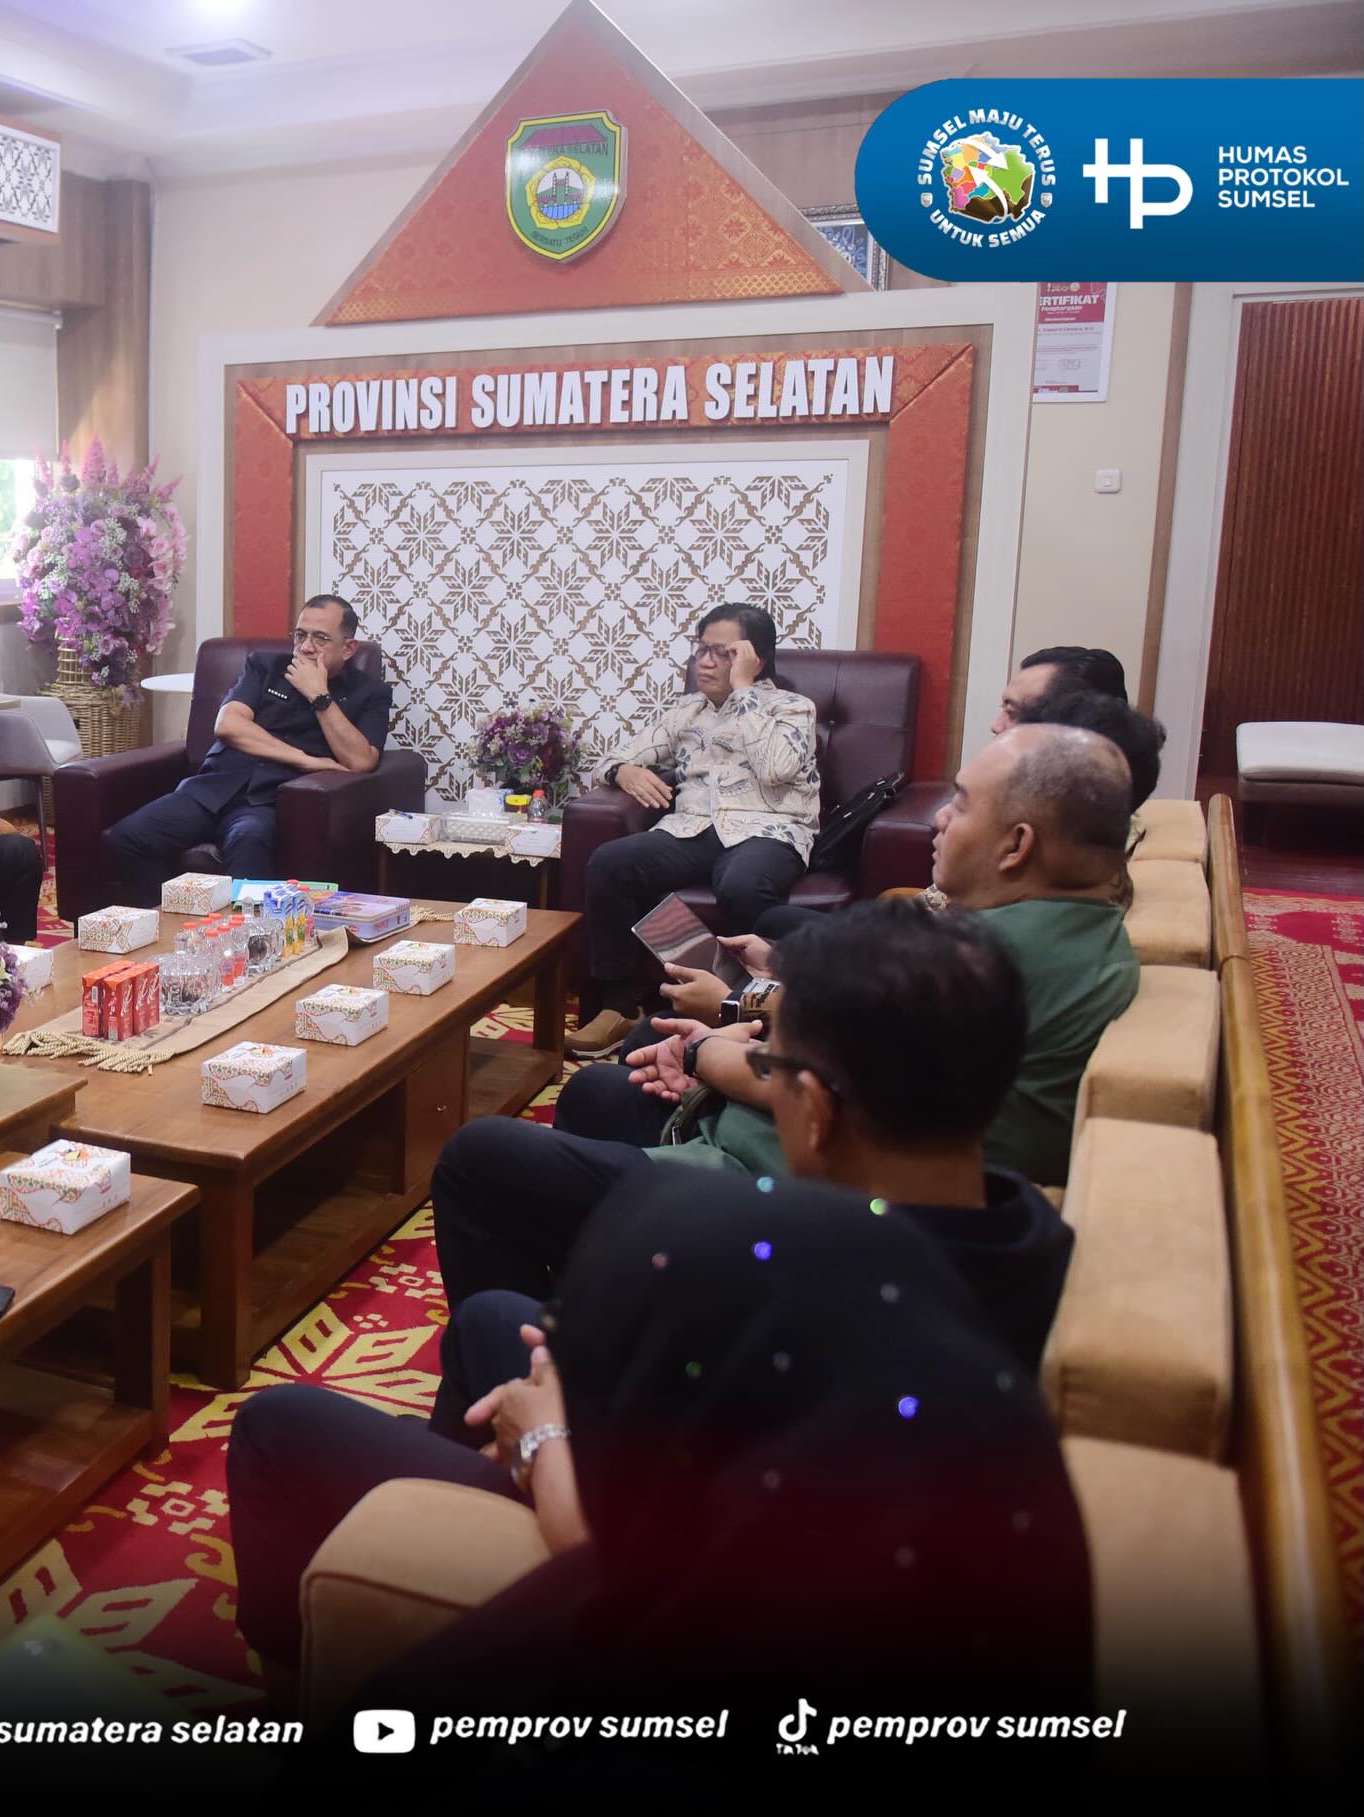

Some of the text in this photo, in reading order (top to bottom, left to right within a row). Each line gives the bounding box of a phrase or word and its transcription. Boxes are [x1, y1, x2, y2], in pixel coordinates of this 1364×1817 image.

[1039, 294, 1100, 306] ERTIFIKAT
[285, 355, 895, 434] PROVINSI SUMATERA SELATAN
